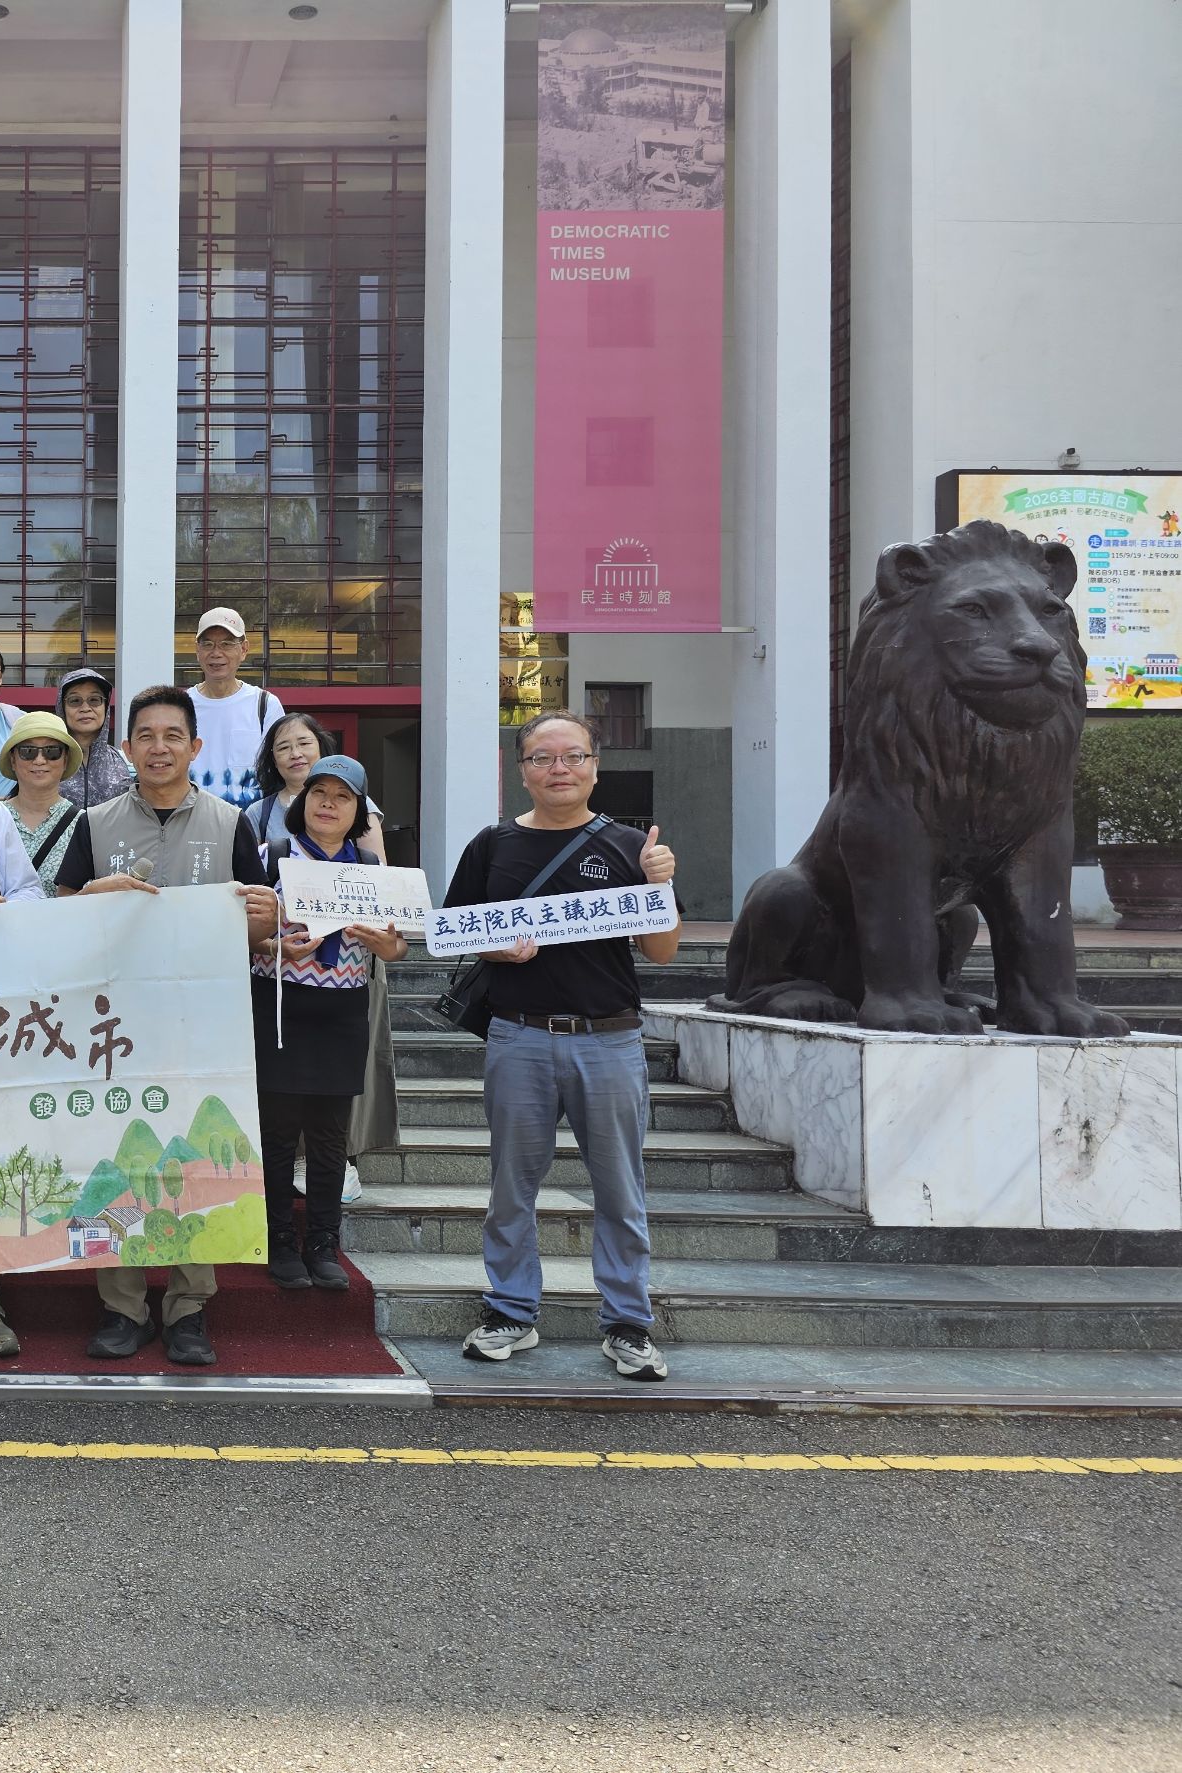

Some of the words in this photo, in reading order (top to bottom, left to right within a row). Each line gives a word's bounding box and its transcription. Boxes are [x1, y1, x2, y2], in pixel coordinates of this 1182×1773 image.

[550, 224, 670, 239] DEMOCRATIC
[549, 246, 605, 260] TIMES
[550, 267, 630, 281] MUSEUM
[1024, 488, 1129, 509] 2026全國古蹟日
[1089, 536, 1101, 547] 走
[581, 590, 671, 604] 民主時刻館
[295, 898, 425, 920] 立法院民主議政園區
[434, 890, 667, 937] 立法院民主議政園區
[434, 937, 486, 951] Democratic
[488, 932, 532, 944] Assembly
[534, 928, 565, 939] Affairs
[568, 926, 591, 935] Park,
[593, 920, 644, 932] Legislative
[645, 917, 670, 927] Yuan
[31, 1088, 167, 1118] 發展協會
